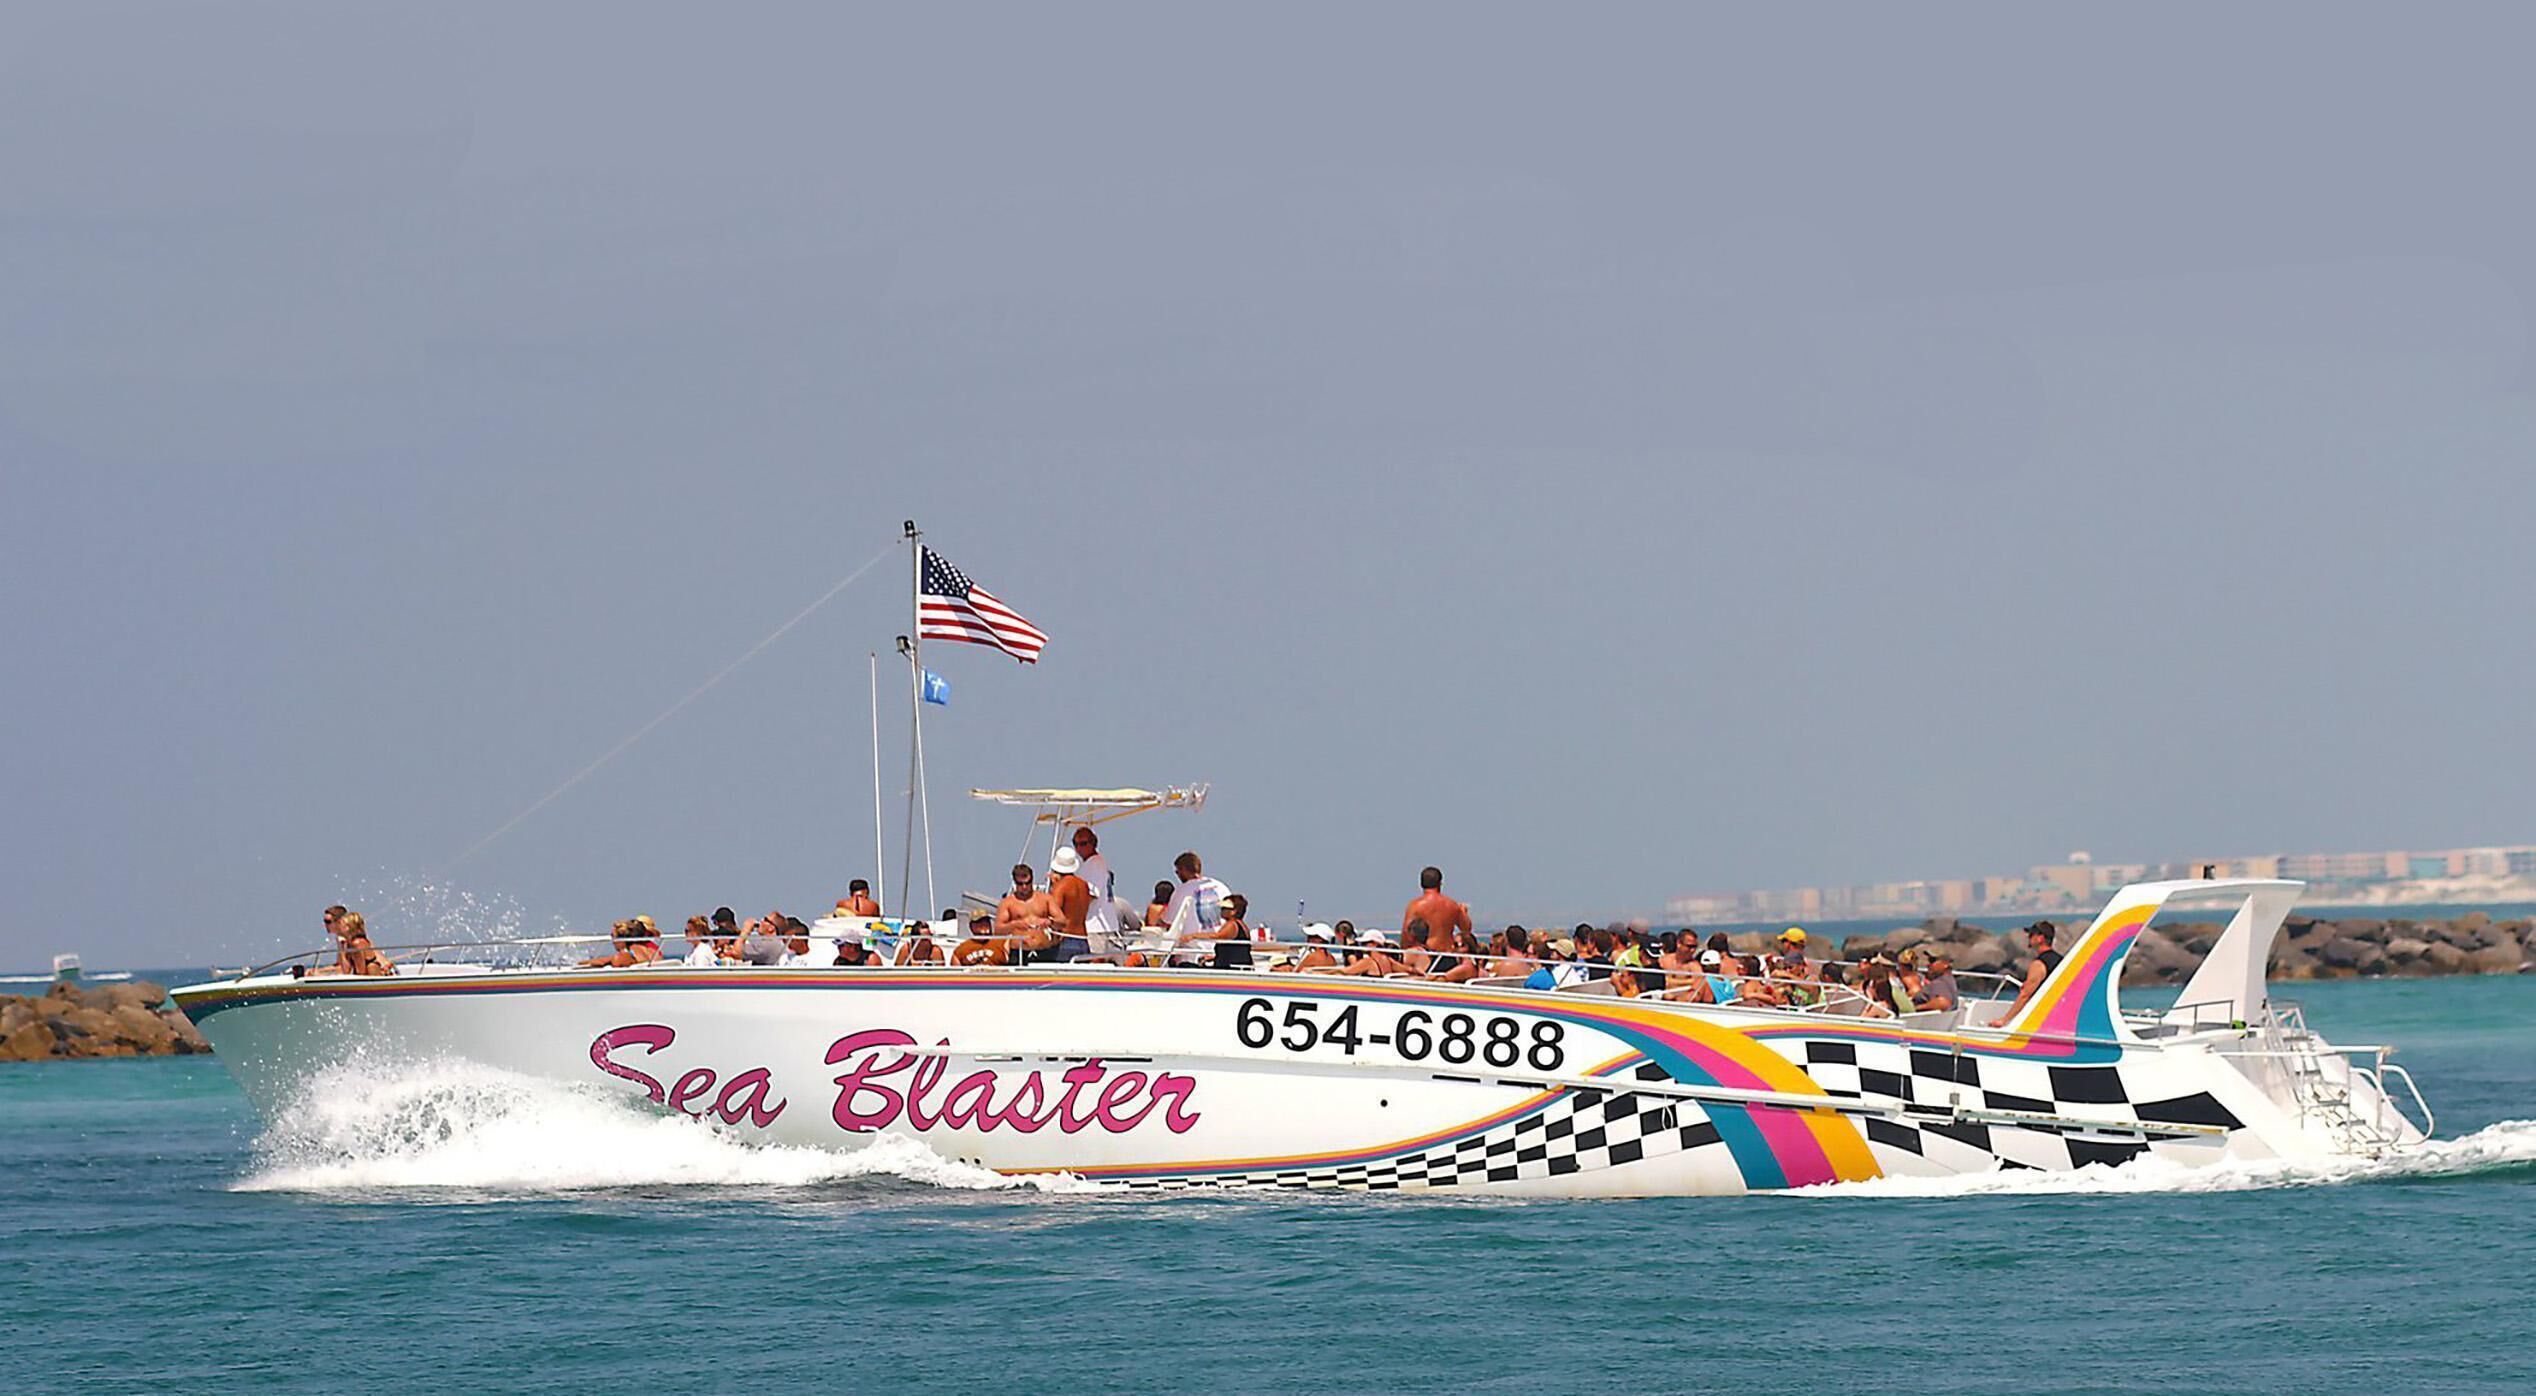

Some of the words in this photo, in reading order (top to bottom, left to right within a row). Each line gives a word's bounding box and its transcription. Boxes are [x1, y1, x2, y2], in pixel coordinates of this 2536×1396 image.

[590, 1024, 787, 1128] Sea
[824, 1028, 1201, 1133] Blaster
[1236, 998, 1565, 1071] 654-6888
